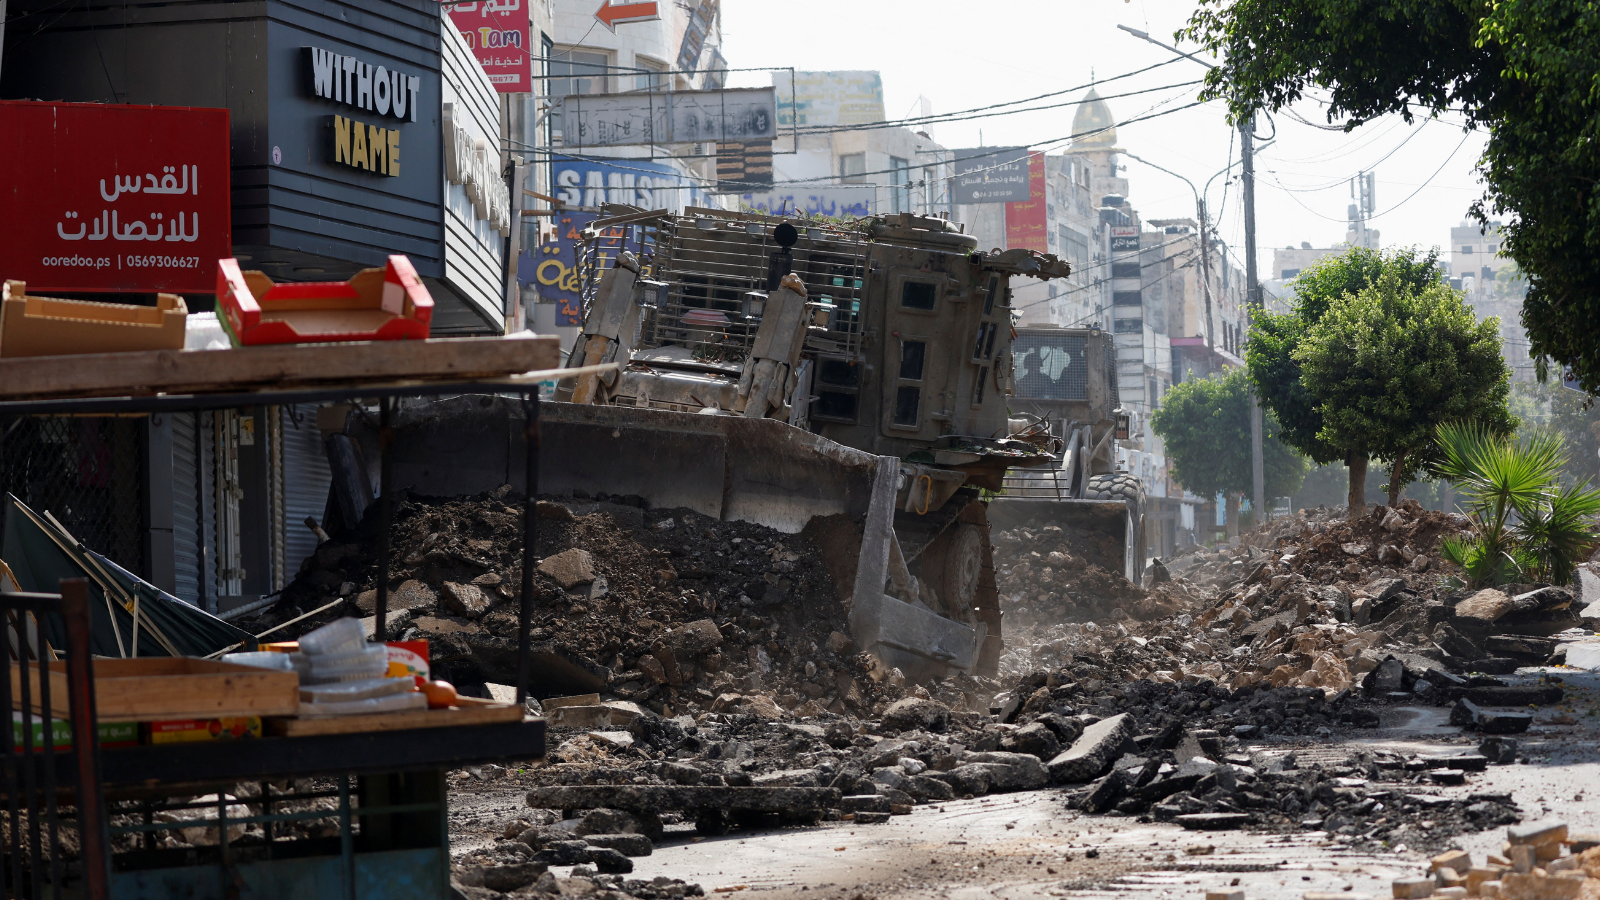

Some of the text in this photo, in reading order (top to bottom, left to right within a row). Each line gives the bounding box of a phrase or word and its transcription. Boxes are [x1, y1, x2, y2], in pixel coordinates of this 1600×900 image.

[478, 27, 521, 48] Tam
[311, 46, 420, 122] WITHOUT
[334, 114, 400, 177] NAME
[100, 164, 198, 202] القدس
[57, 209, 199, 242] للاتصالات
[42, 254, 110, 270] ooredoo.ps
[127, 255, 200, 268] 0569306627
